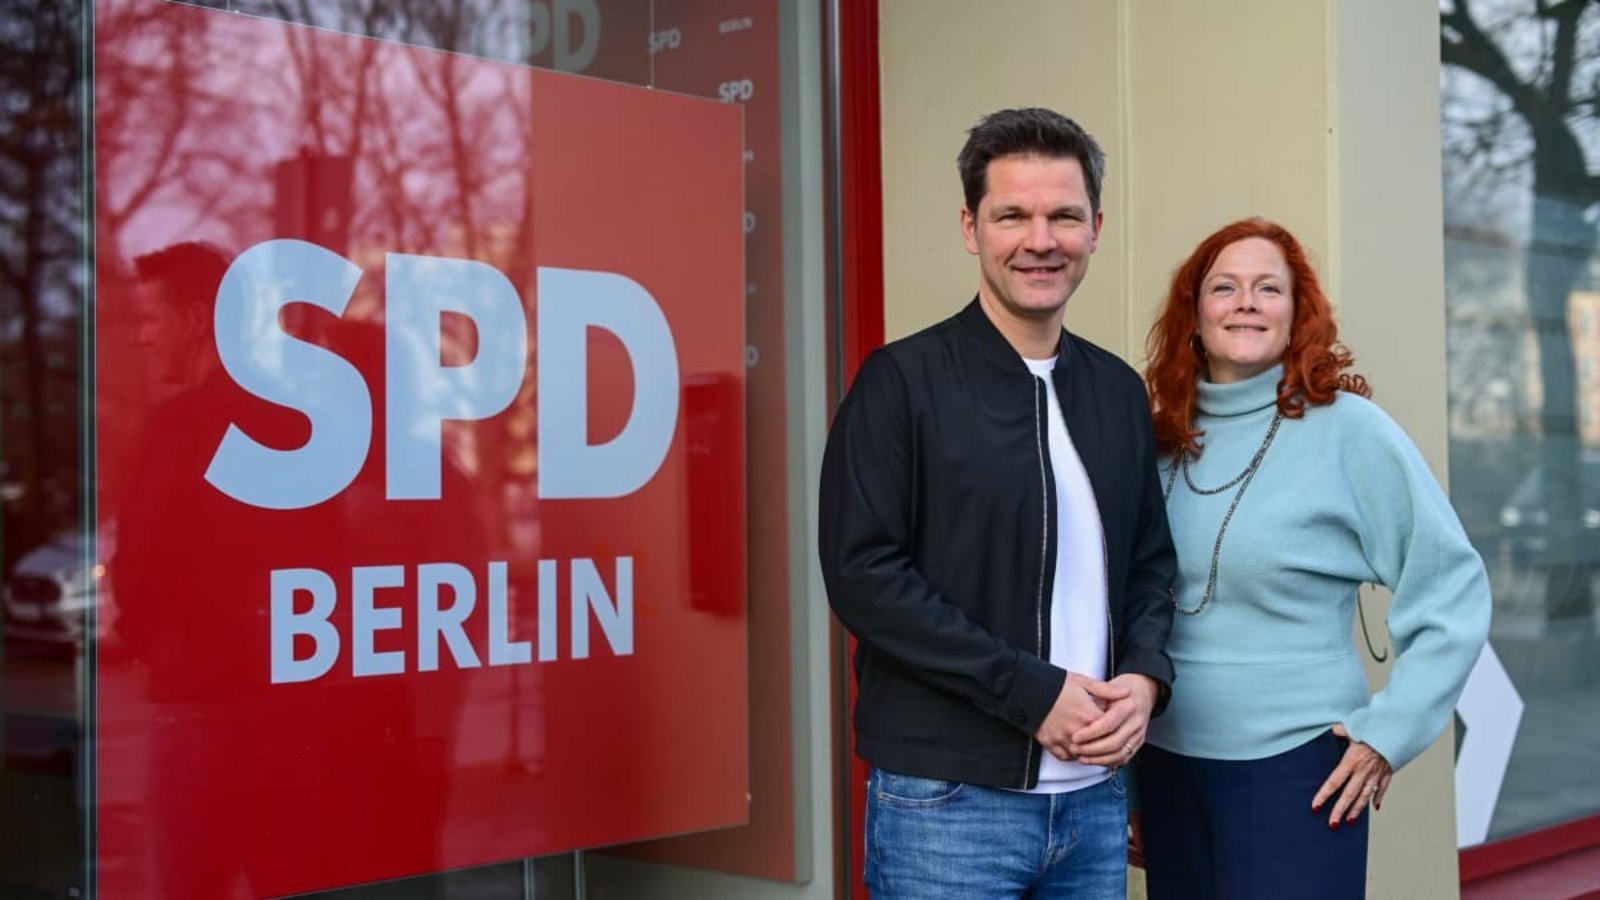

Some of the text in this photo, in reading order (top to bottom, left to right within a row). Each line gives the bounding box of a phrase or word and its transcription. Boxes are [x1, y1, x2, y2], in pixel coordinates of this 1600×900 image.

[648, 28, 681, 53] SPD
[719, 79, 753, 103] SPD
[205, 239, 679, 509] SPD
[269, 556, 634, 684] BERLIN
